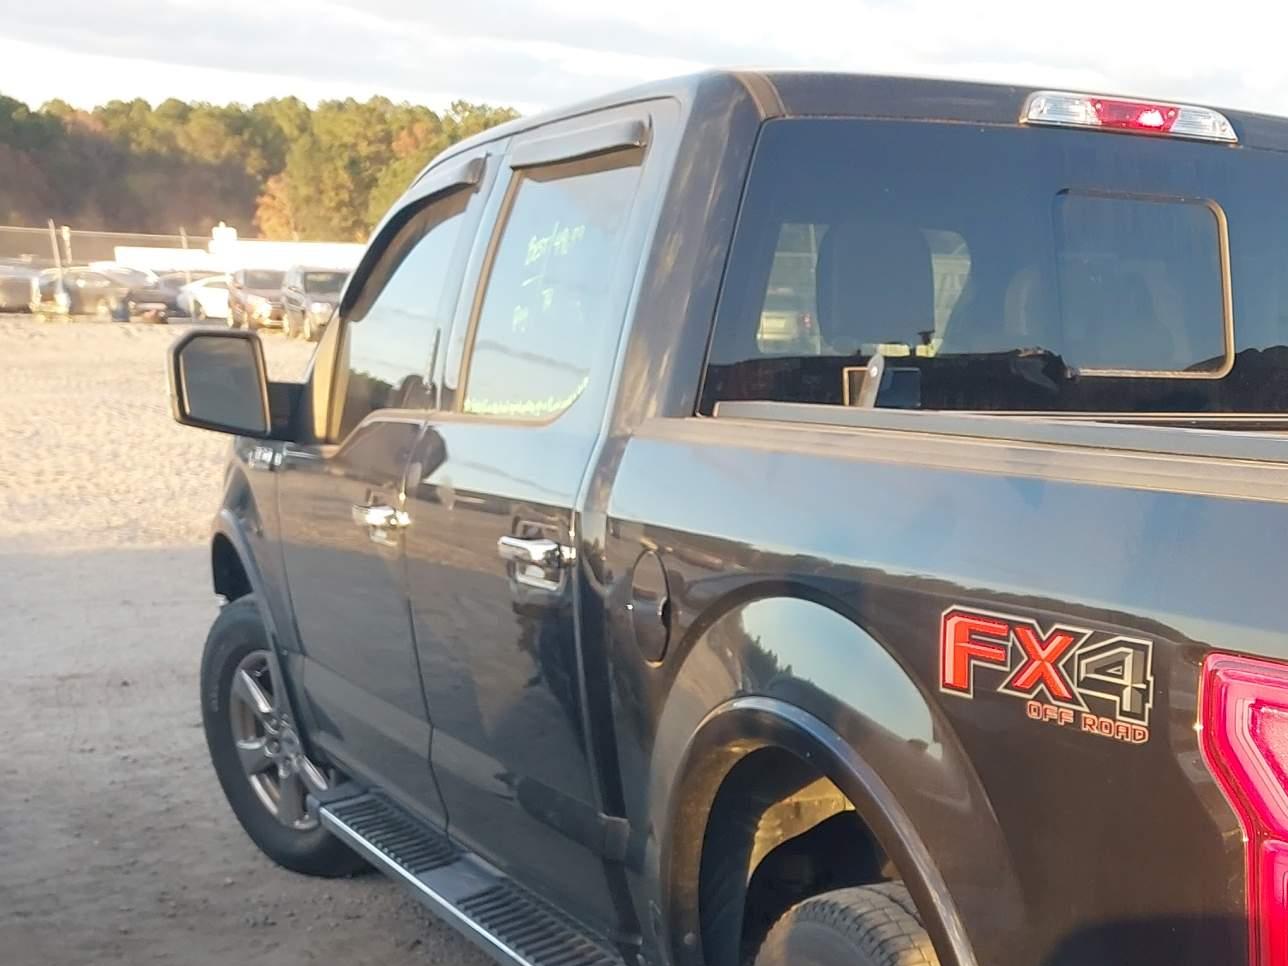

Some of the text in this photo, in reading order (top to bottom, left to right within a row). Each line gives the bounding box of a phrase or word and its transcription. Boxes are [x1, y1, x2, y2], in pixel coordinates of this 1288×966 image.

[939, 604, 1154, 726] FX4
[1026, 700, 1149, 744] OFF ROAD
